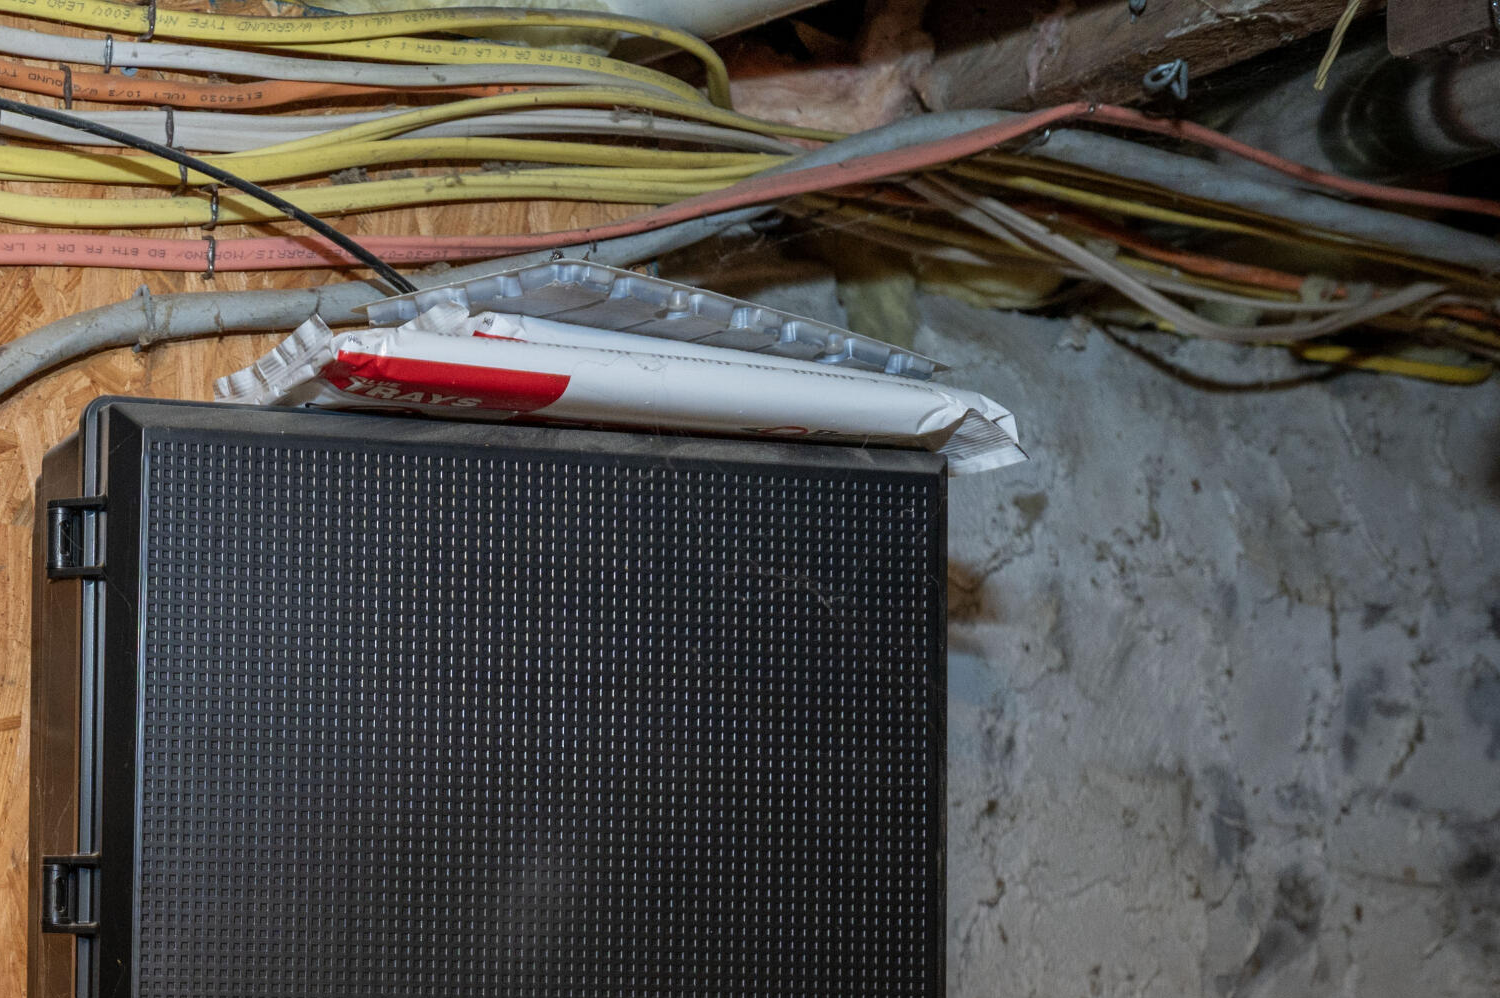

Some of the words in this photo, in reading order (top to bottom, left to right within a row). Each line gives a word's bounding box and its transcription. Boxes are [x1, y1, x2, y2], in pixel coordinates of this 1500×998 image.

[92, 7, 131, 20] 600V
[188, 17, 225, 30] TYPE
[27, 72, 98, 97] W/GOUND
[108, 89, 141, 98] 10/3
[3, 241, 26, 252] LR
[35, 243, 46, 252] K
[56, 243, 76, 254] DR
[84, 244, 103, 255] FR
